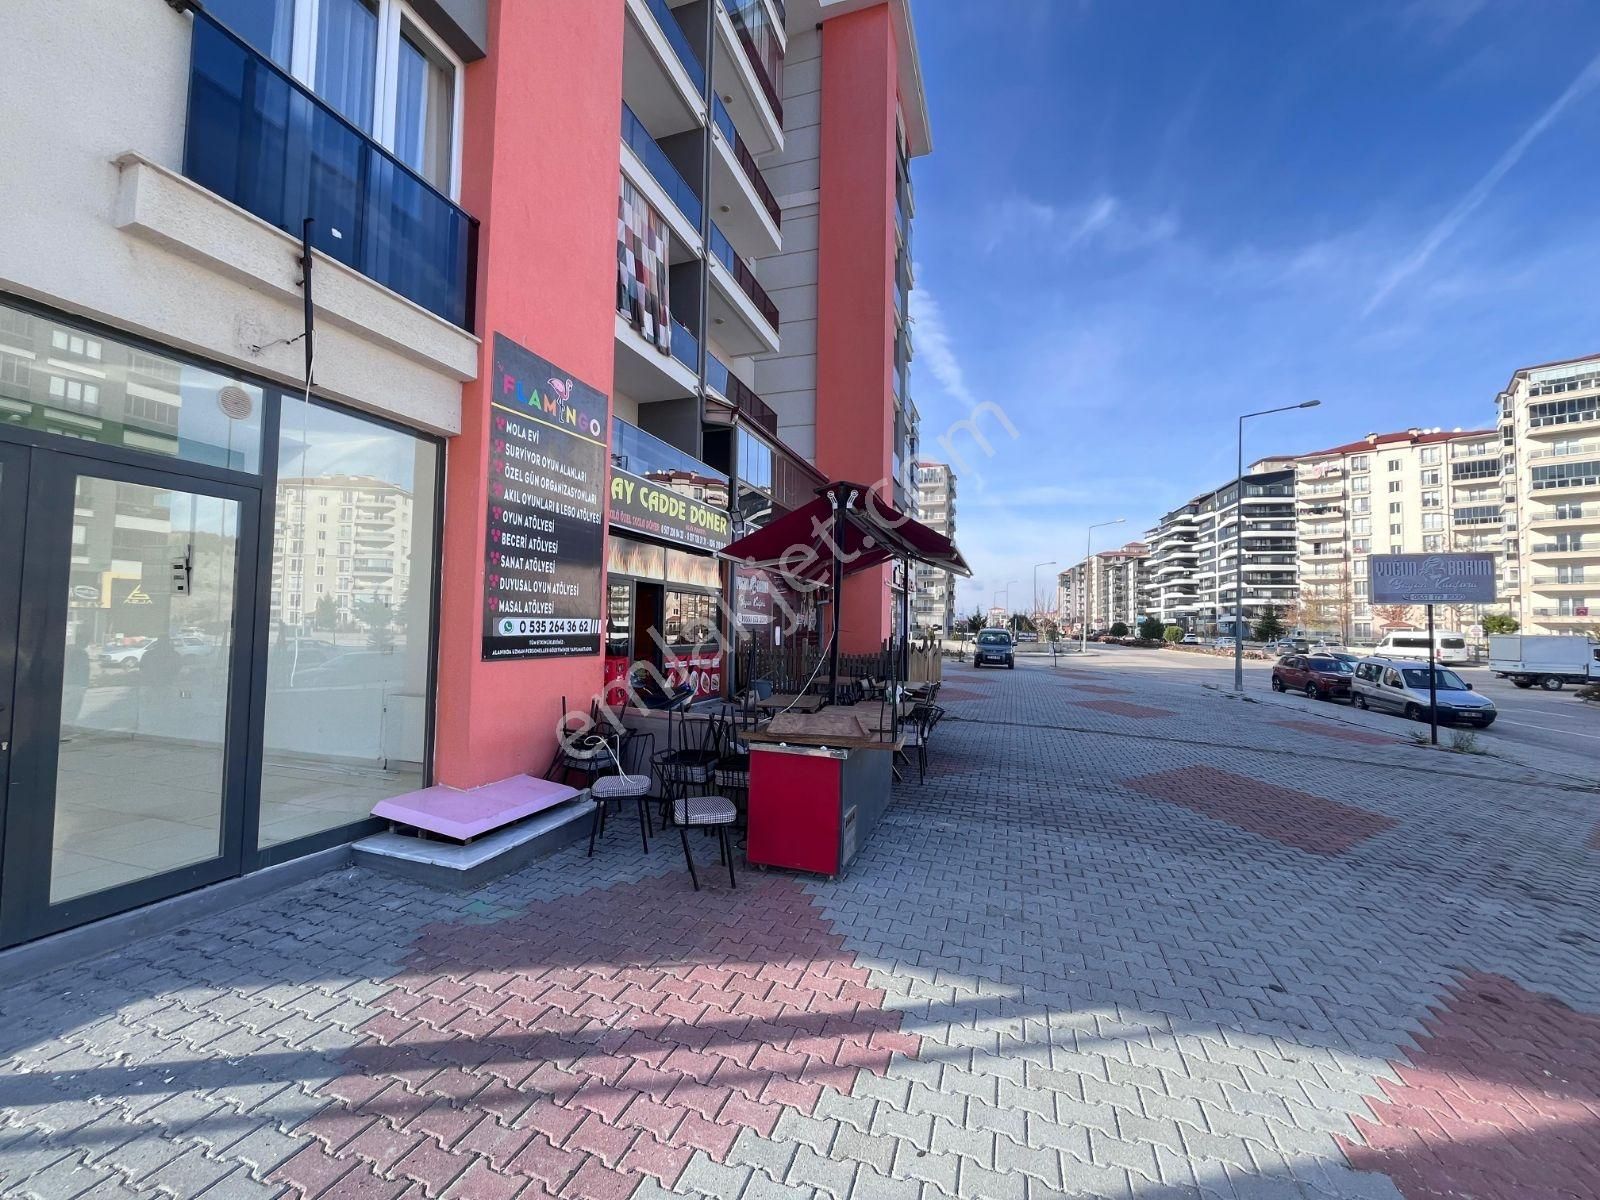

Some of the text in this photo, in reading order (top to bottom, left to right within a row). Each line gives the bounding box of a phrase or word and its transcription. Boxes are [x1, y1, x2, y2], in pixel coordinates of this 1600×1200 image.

[506, 421, 539, 444] MOLA EVİ
[505, 443, 587, 483] SURVİVOR OYUN ALANLARI
[505, 463, 523, 482] ÖZEL
[524, 471, 539, 486] GÜN
[504, 488, 521, 504] AKIL
[522, 493, 555, 512] OYUNLARI
[560, 503, 576, 518] LEGO
[640, 487, 686, 521] CADDE
[690, 505, 728, 536] DÖNER
[502, 511, 555, 533] OYUN ATÖLYESİ
[501, 532, 558, 554] BECERİ ATÖLYESİ
[500, 555, 555, 573] SANAT ATÖLYESİ
[500, 578, 579, 596] DUYUSAL OYUN ATÖLYESİ
[499, 600, 554, 615] MASAL ATÖLYESİ
[520, 620, 588, 633] 0 535 264 36 62
